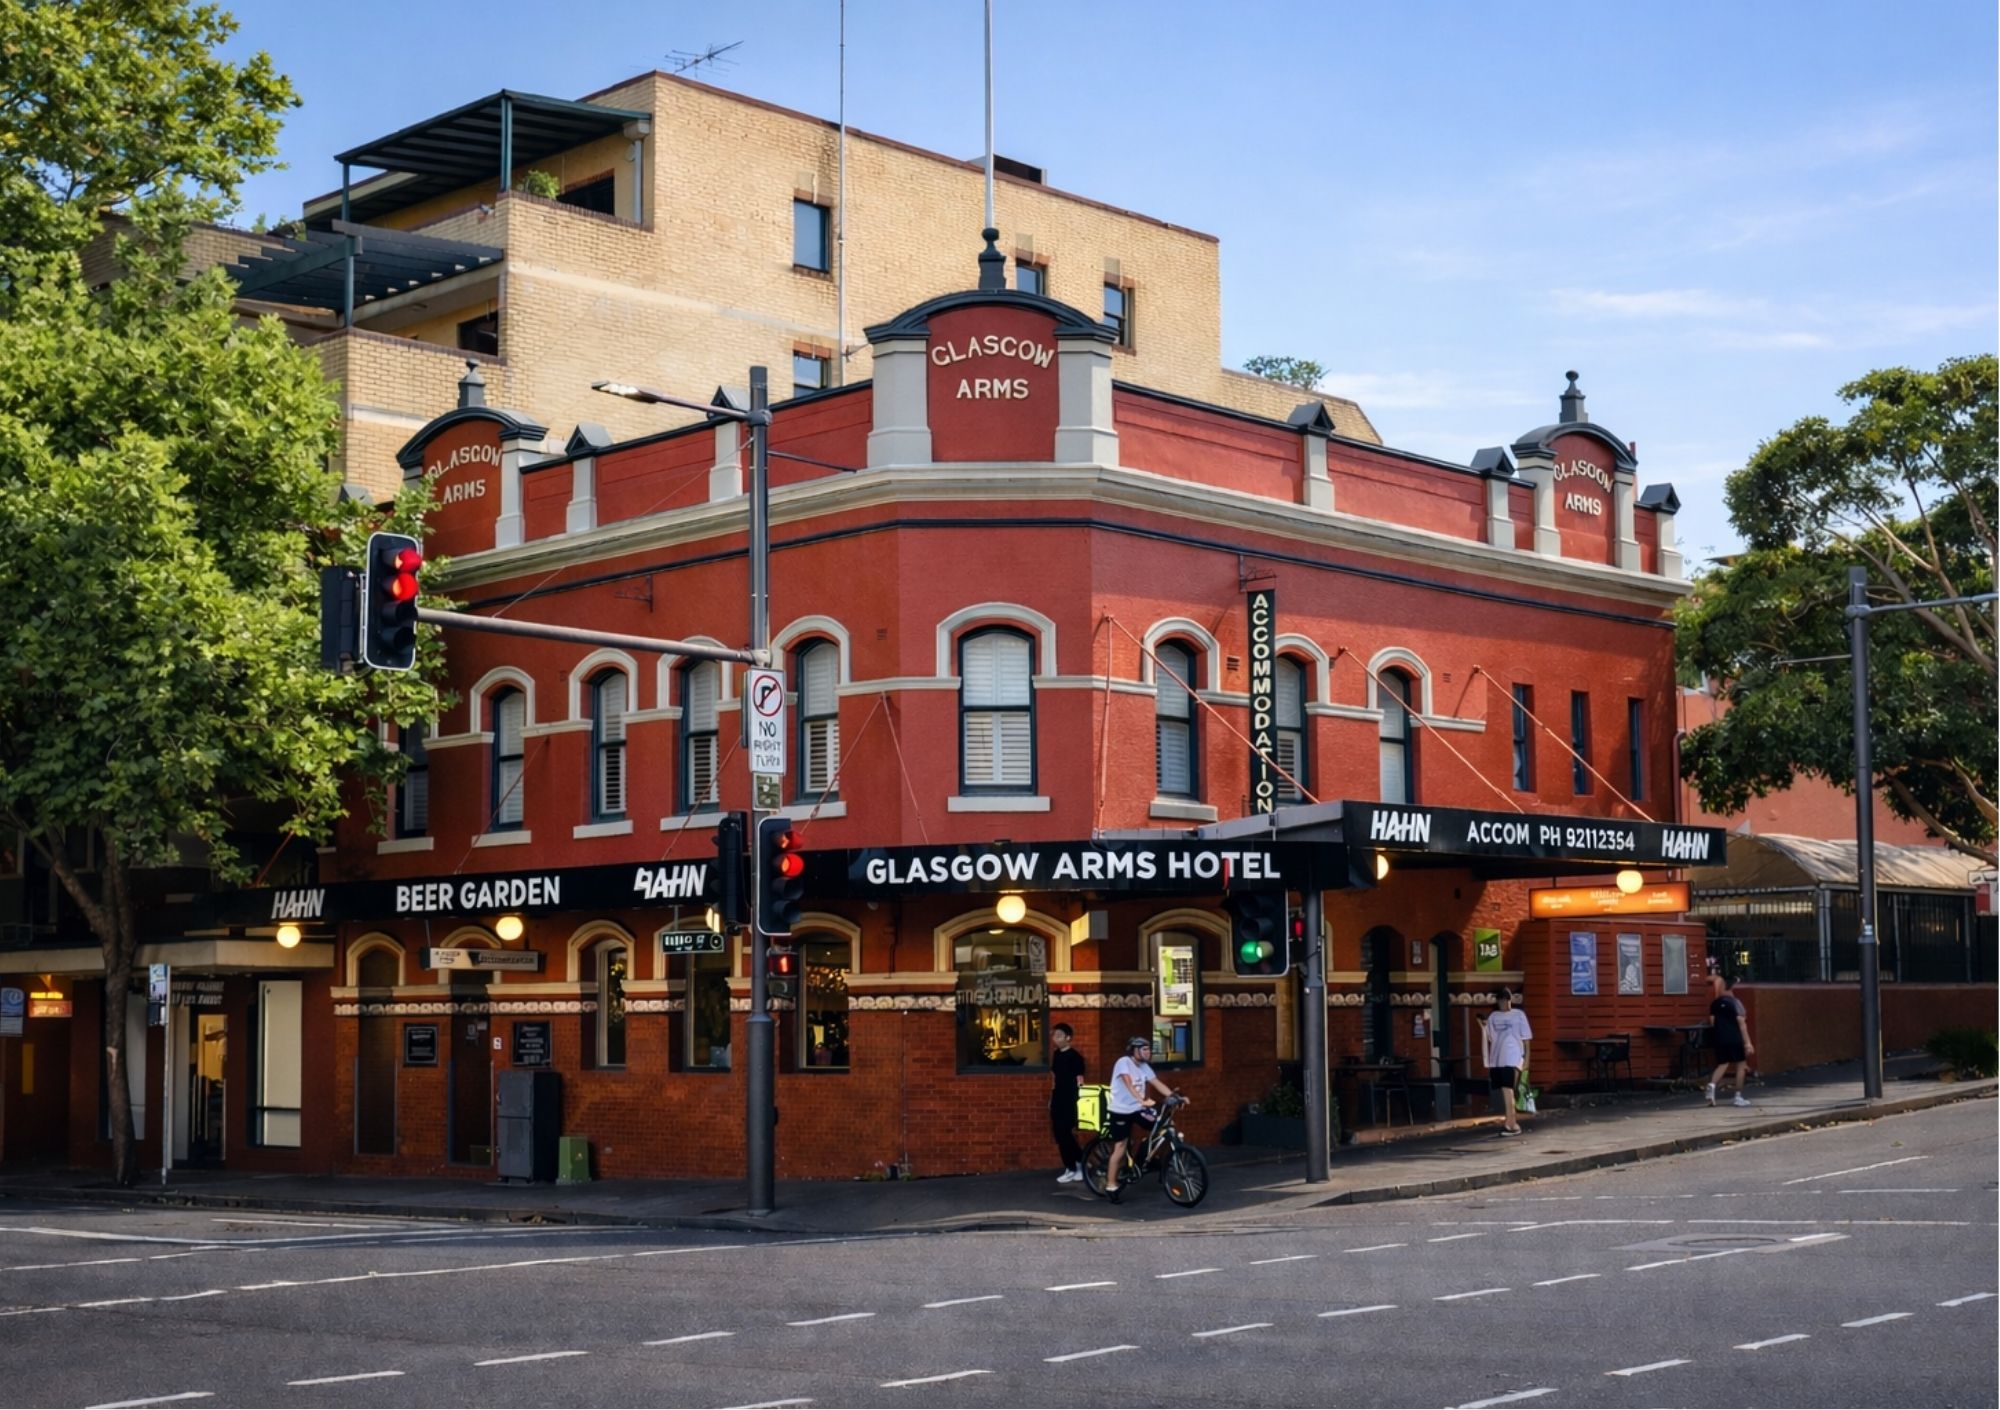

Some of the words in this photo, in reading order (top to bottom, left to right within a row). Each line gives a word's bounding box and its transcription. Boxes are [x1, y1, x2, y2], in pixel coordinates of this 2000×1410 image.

[931, 335, 1055, 368] GLASGOW
[956, 378, 1029, 399] ARMS
[442, 479, 486, 504] ARMS
[1565, 492, 1602, 516] ARMS
[1252, 593, 1273, 814] ACCOMMODATION
[759, 721, 777, 738] NO
[1370, 810, 1431, 843] HAHN
[1467, 820, 1530, 845] ACCOM
[1540, 825, 1561, 847] PH
[1661, 829, 1710, 860] HAHN
[866, 852, 1040, 885] GLASGOW
[1051, 851, 1157, 879] ARMS
[1168, 851, 1281, 879] HOTEL
[271, 888, 326, 919] HAHN
[396, 883, 454, 912] BEER
[460, 875, 561, 910] GARDEN
